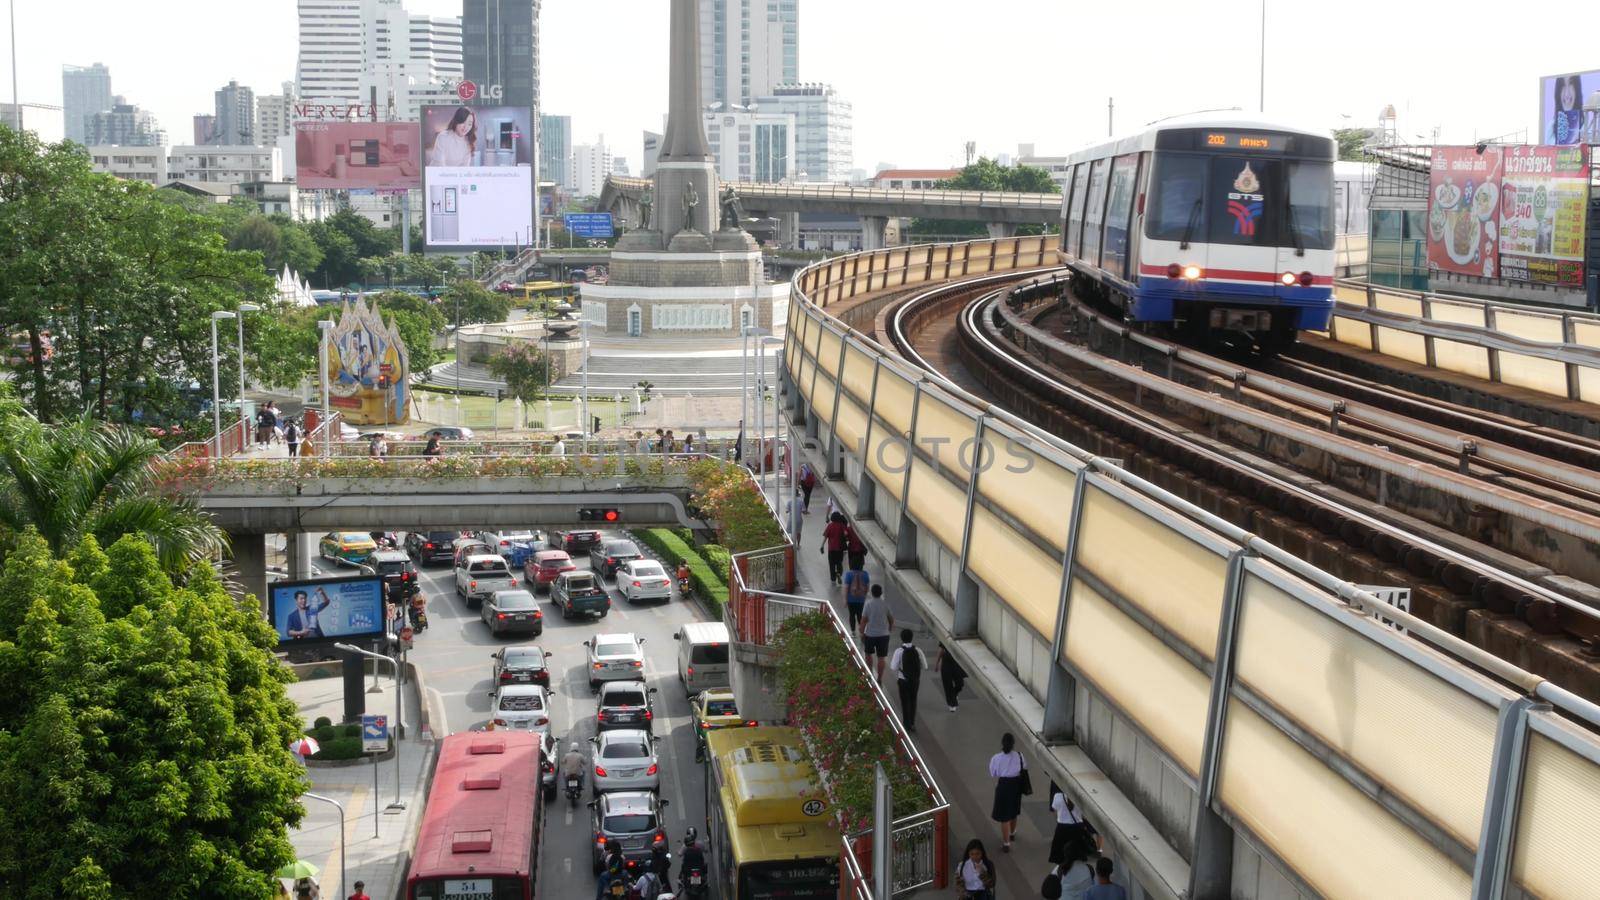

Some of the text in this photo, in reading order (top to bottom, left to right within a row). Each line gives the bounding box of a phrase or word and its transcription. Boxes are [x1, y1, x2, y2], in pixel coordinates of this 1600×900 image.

[480, 84, 503, 99] LG
[1207, 135, 1225, 145] 202
[1228, 192, 1264, 201] BTS
[805, 802, 821, 813] 42
